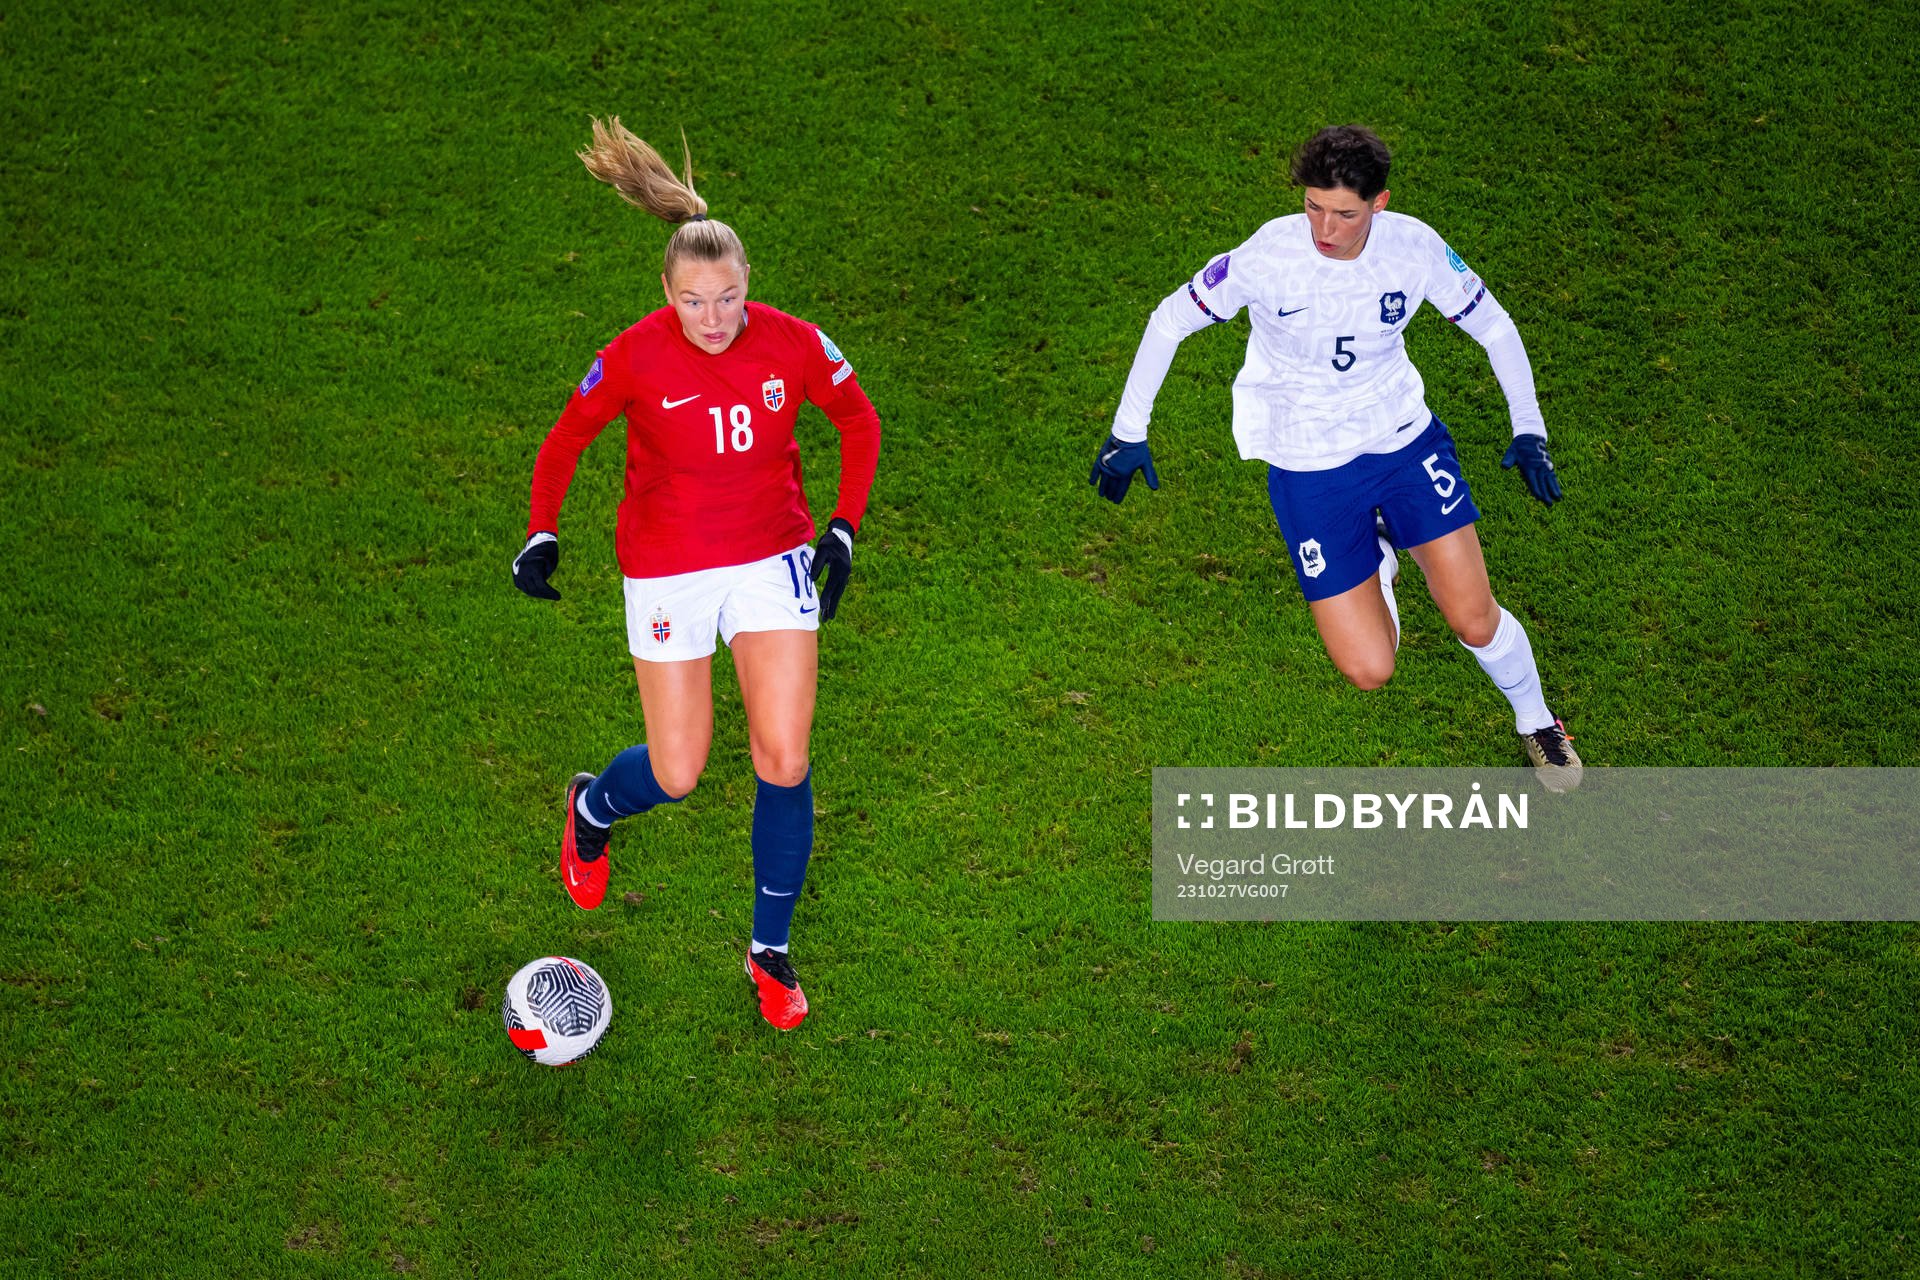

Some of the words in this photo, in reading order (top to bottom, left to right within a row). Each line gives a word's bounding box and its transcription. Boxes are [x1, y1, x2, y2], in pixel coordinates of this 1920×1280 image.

[1331, 336, 1356, 372] 5
[708, 404, 754, 454] 18
[1422, 453, 1456, 498] 5
[782, 550, 813, 600] 18
